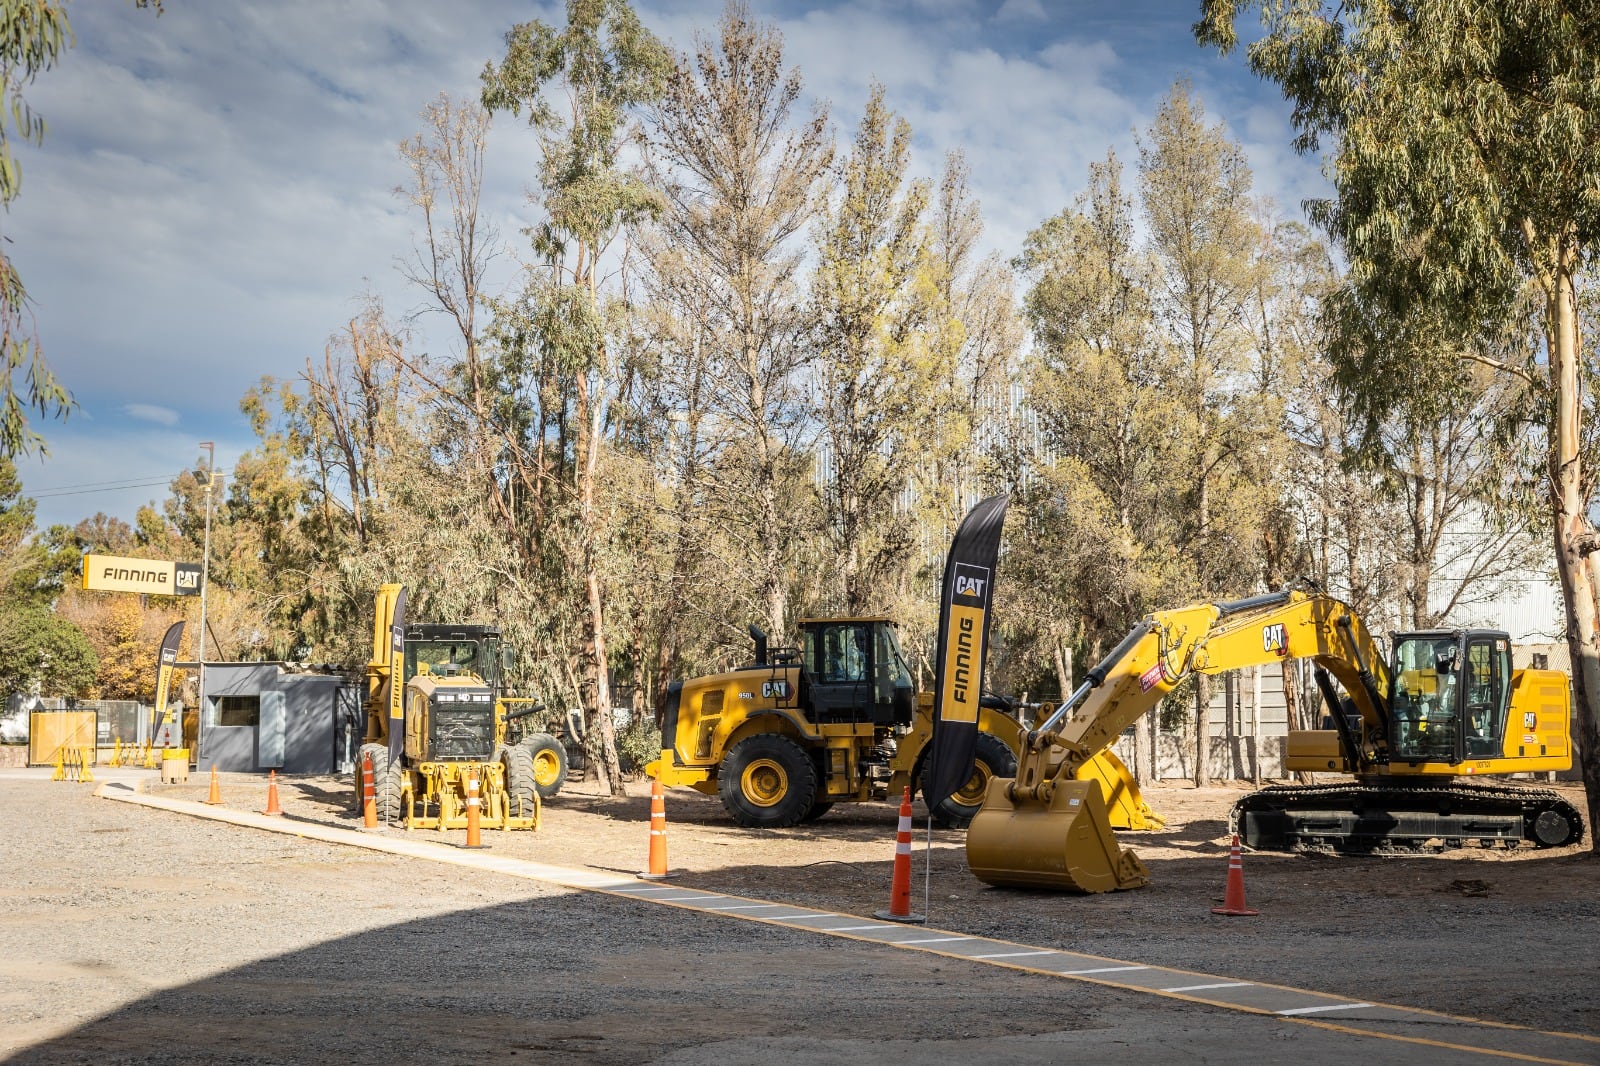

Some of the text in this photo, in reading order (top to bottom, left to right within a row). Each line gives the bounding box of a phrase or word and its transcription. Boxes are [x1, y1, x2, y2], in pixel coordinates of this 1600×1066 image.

[103, 568, 168, 583] FINNING
[176, 570, 200, 588] CAT
[955, 575, 984, 598] CAT
[1263, 624, 1283, 652] CAT
[954, 617, 974, 704] FINNING
[761, 682, 785, 698] CAT
[1524, 712, 1535, 728] CAT
